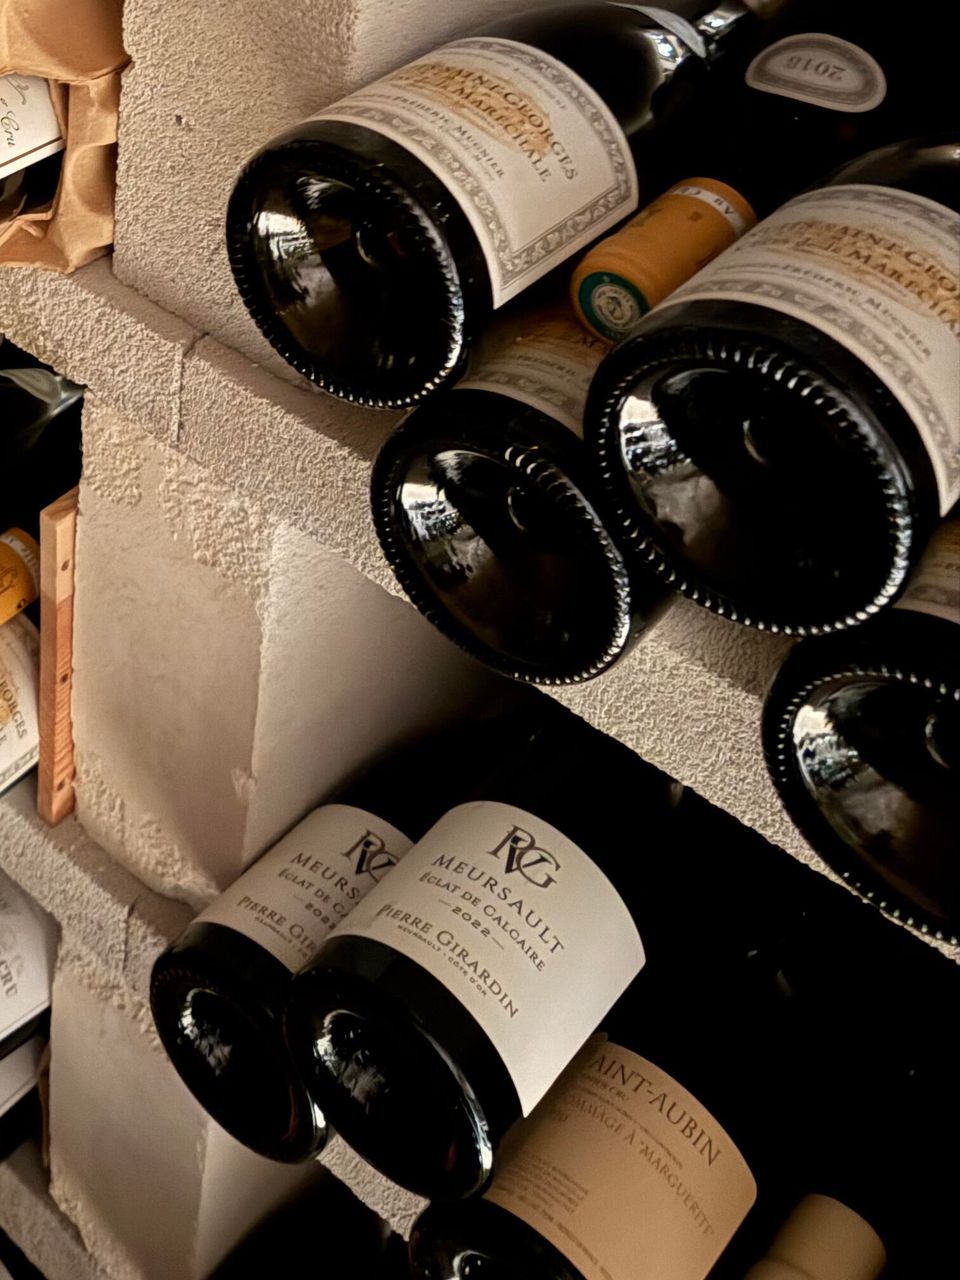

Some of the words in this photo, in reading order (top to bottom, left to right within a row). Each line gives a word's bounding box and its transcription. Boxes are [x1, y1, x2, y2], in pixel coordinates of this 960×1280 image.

[0, 110, 20, 147] Cru
[289, 852, 361, 905] MEURS
[313, 887, 332, 903] DE
[431, 854, 565, 955] MEURSAULT
[236, 895, 288, 927] PIERRE
[418, 870, 462, 894] ÉCLAT
[460, 890, 481, 907] DE
[482, 904, 547, 972] CALCAIRE
[451, 905, 492, 938] 2022
[375, 902, 434, 935] PIERRE
[435, 929, 520, 1019] GIRARDIN
[588, 1054, 722, 1167] AINT-AUBIN
